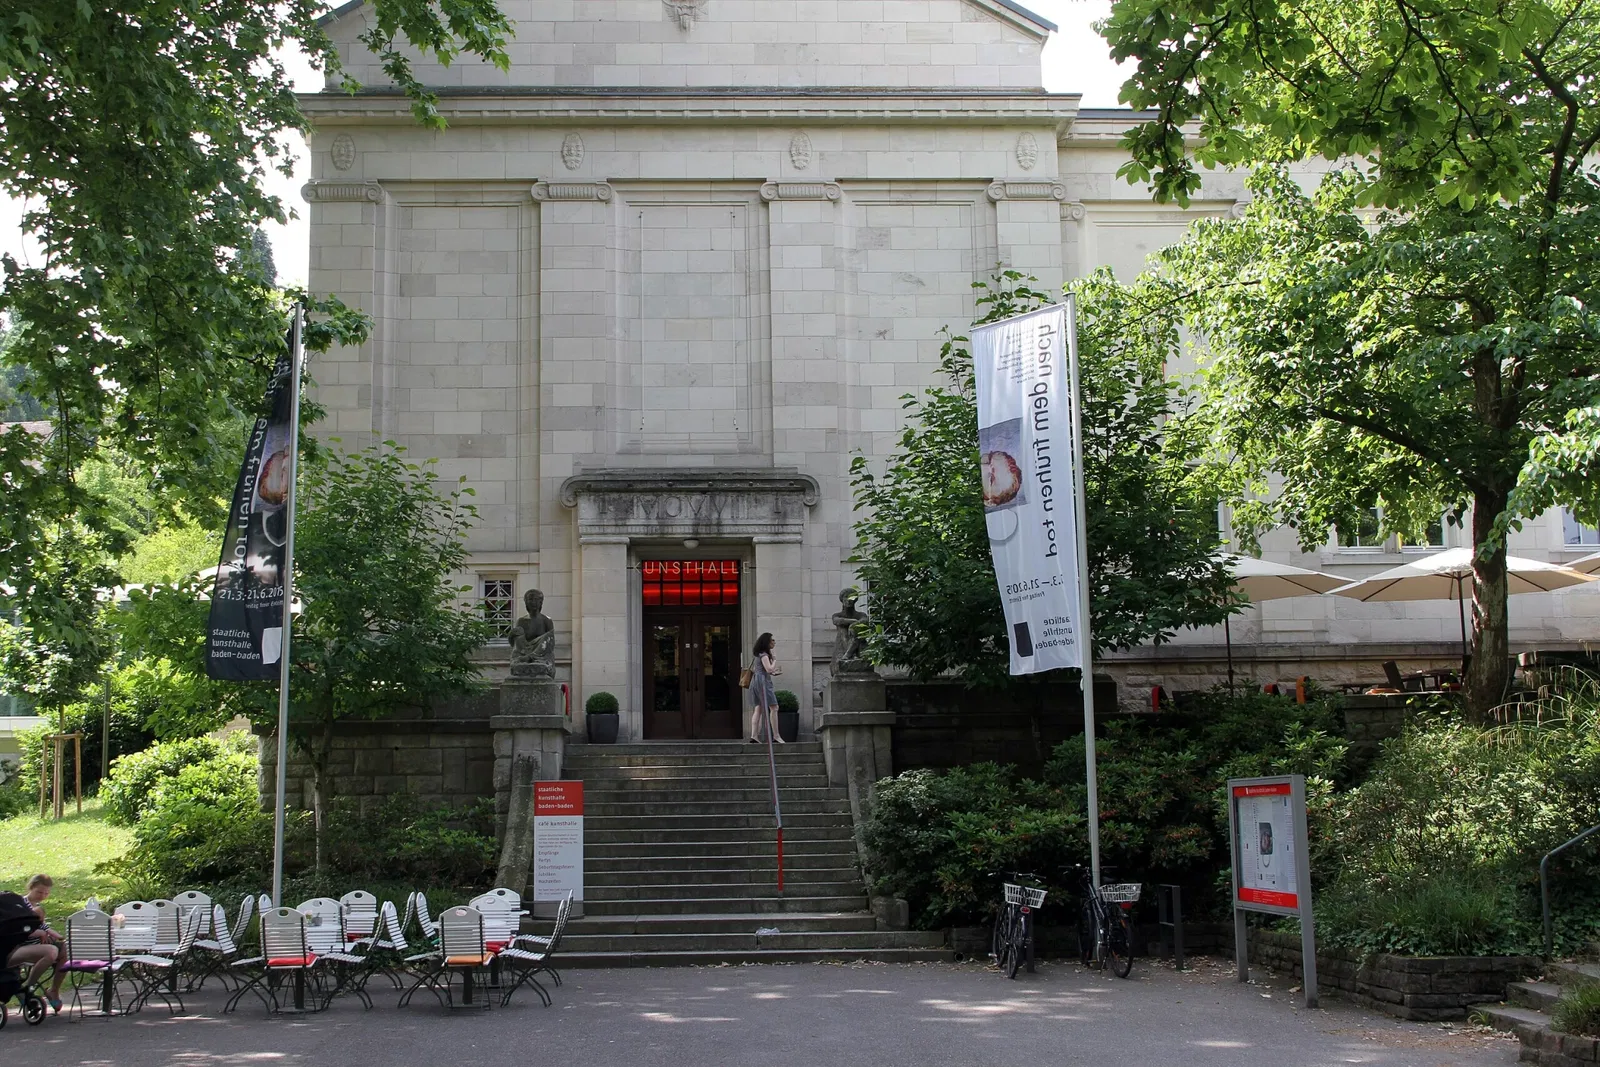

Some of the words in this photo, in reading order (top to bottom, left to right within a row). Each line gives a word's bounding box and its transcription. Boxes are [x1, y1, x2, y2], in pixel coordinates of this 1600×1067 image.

[252, 418, 268, 451] em
[632, 561, 751, 574] KUNSTHALLE
[212, 638, 252, 649] kunsthalle
[211, 649, 260, 660] baden-baden
